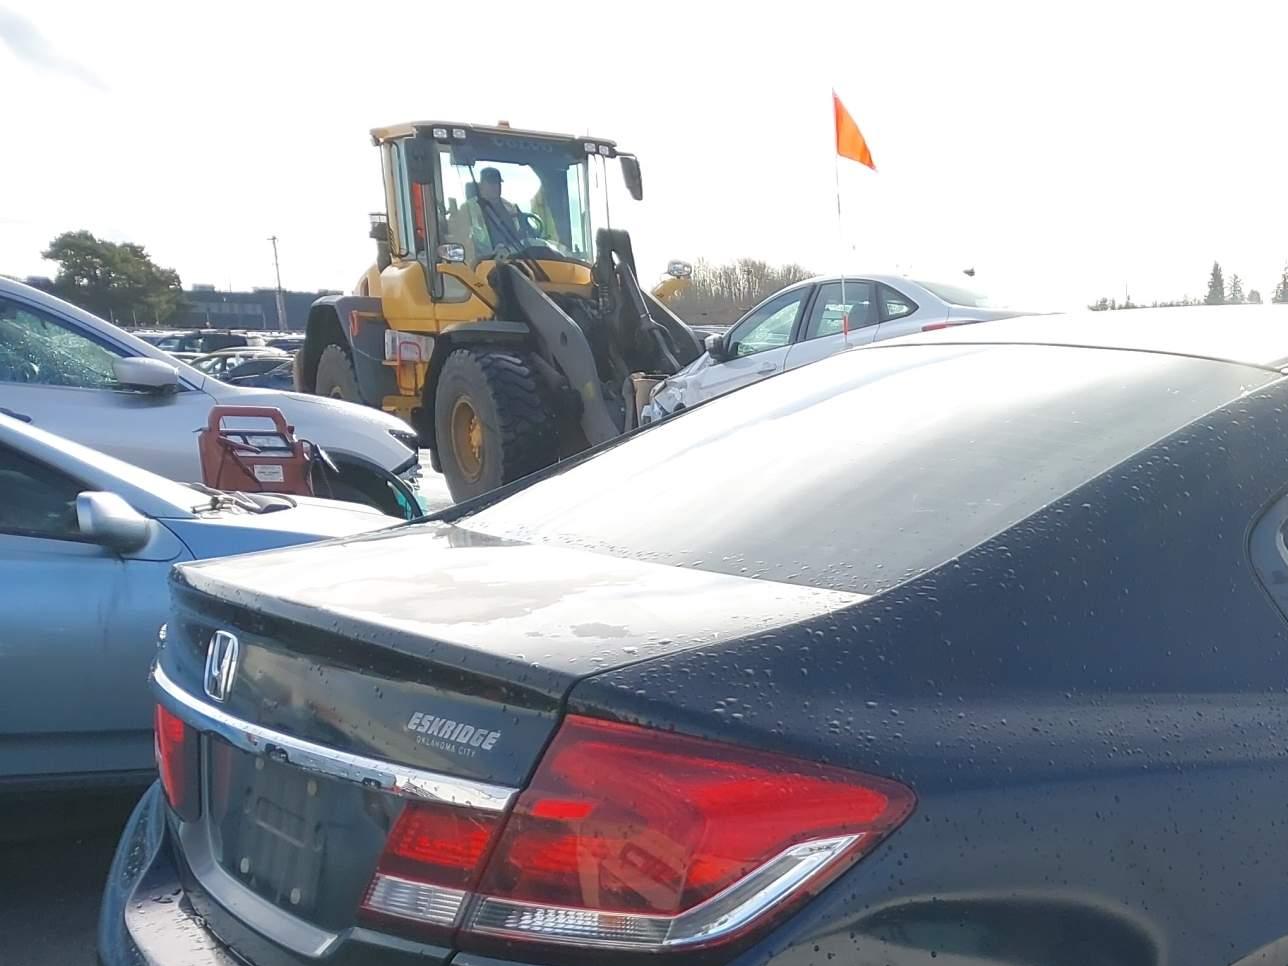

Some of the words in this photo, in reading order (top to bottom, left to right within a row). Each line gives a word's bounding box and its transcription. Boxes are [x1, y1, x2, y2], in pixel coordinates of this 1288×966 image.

[407, 712, 501, 751] ESKRIDGE
[416, 735, 456, 753] OKLAHOMA
[458, 746, 476, 758] CITY
